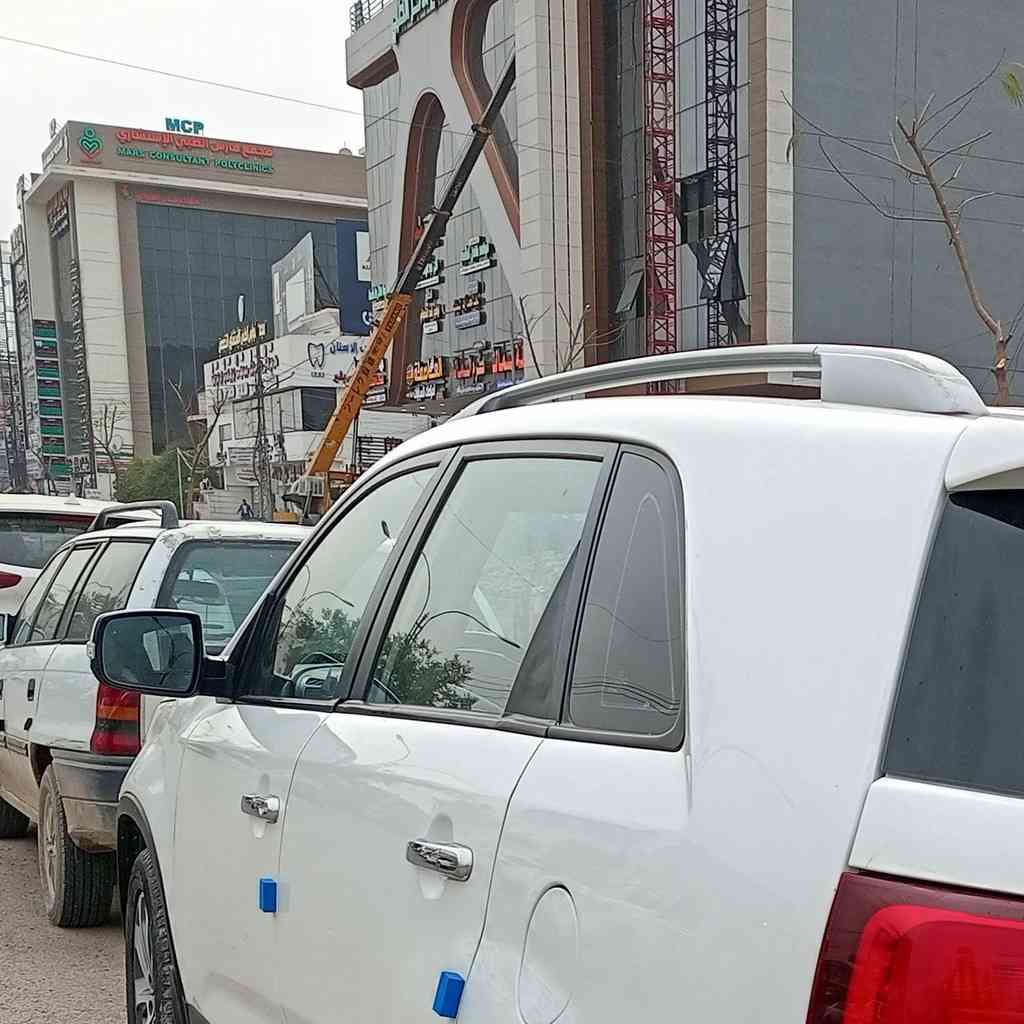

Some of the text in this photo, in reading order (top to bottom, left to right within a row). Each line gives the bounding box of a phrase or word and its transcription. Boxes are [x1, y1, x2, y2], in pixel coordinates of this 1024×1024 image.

[165, 117, 204, 134] MCP
[150, 151, 209, 166] CONSULTANT
[215, 160, 274, 173] POLYCLINICS
